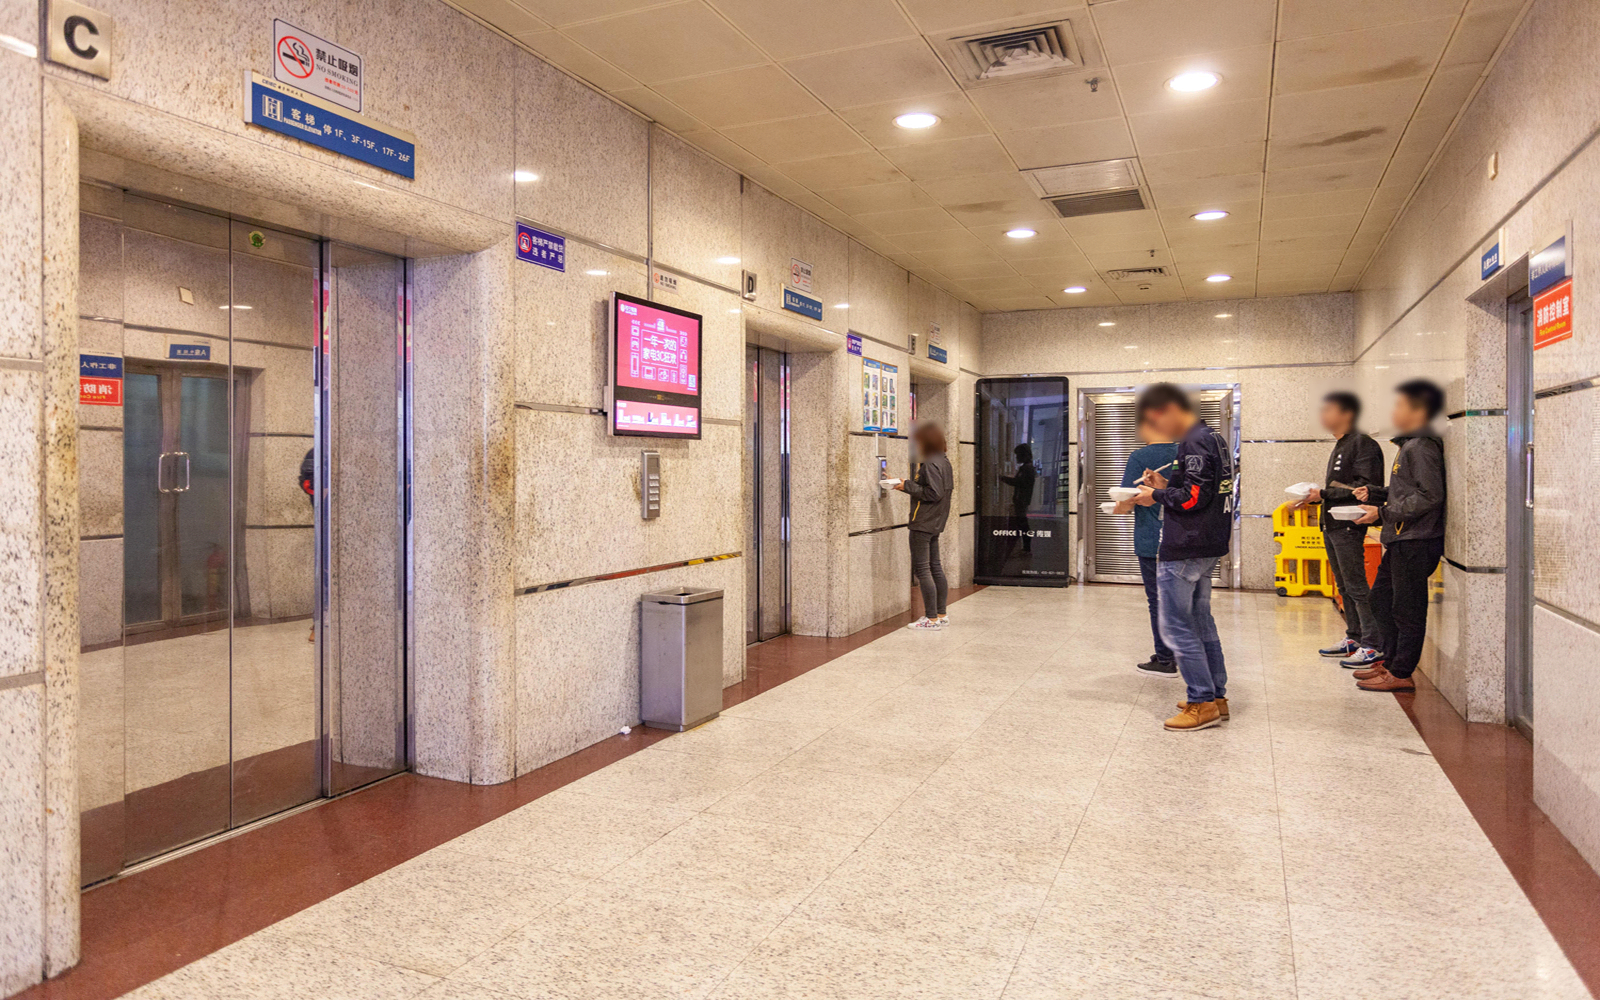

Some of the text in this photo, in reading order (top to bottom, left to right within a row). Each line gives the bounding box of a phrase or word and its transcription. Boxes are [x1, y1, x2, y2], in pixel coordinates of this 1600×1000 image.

[63, 15, 99, 60] C
[315, 48, 359, 77] 禁止吸烟
[315, 63, 326, 73] NO
[327, 68, 359, 87] SMOKING
[290, 108, 316, 127] 客梯
[322, 124, 333, 136] 停
[748, 276, 754, 293] D
[1537, 295, 1569, 327] 消防控制室
[643, 335, 677, 352] 一年一次的
[642, 347, 677, 365] 家电3C狂欢
[992, 529, 1017, 537] OFFICE
